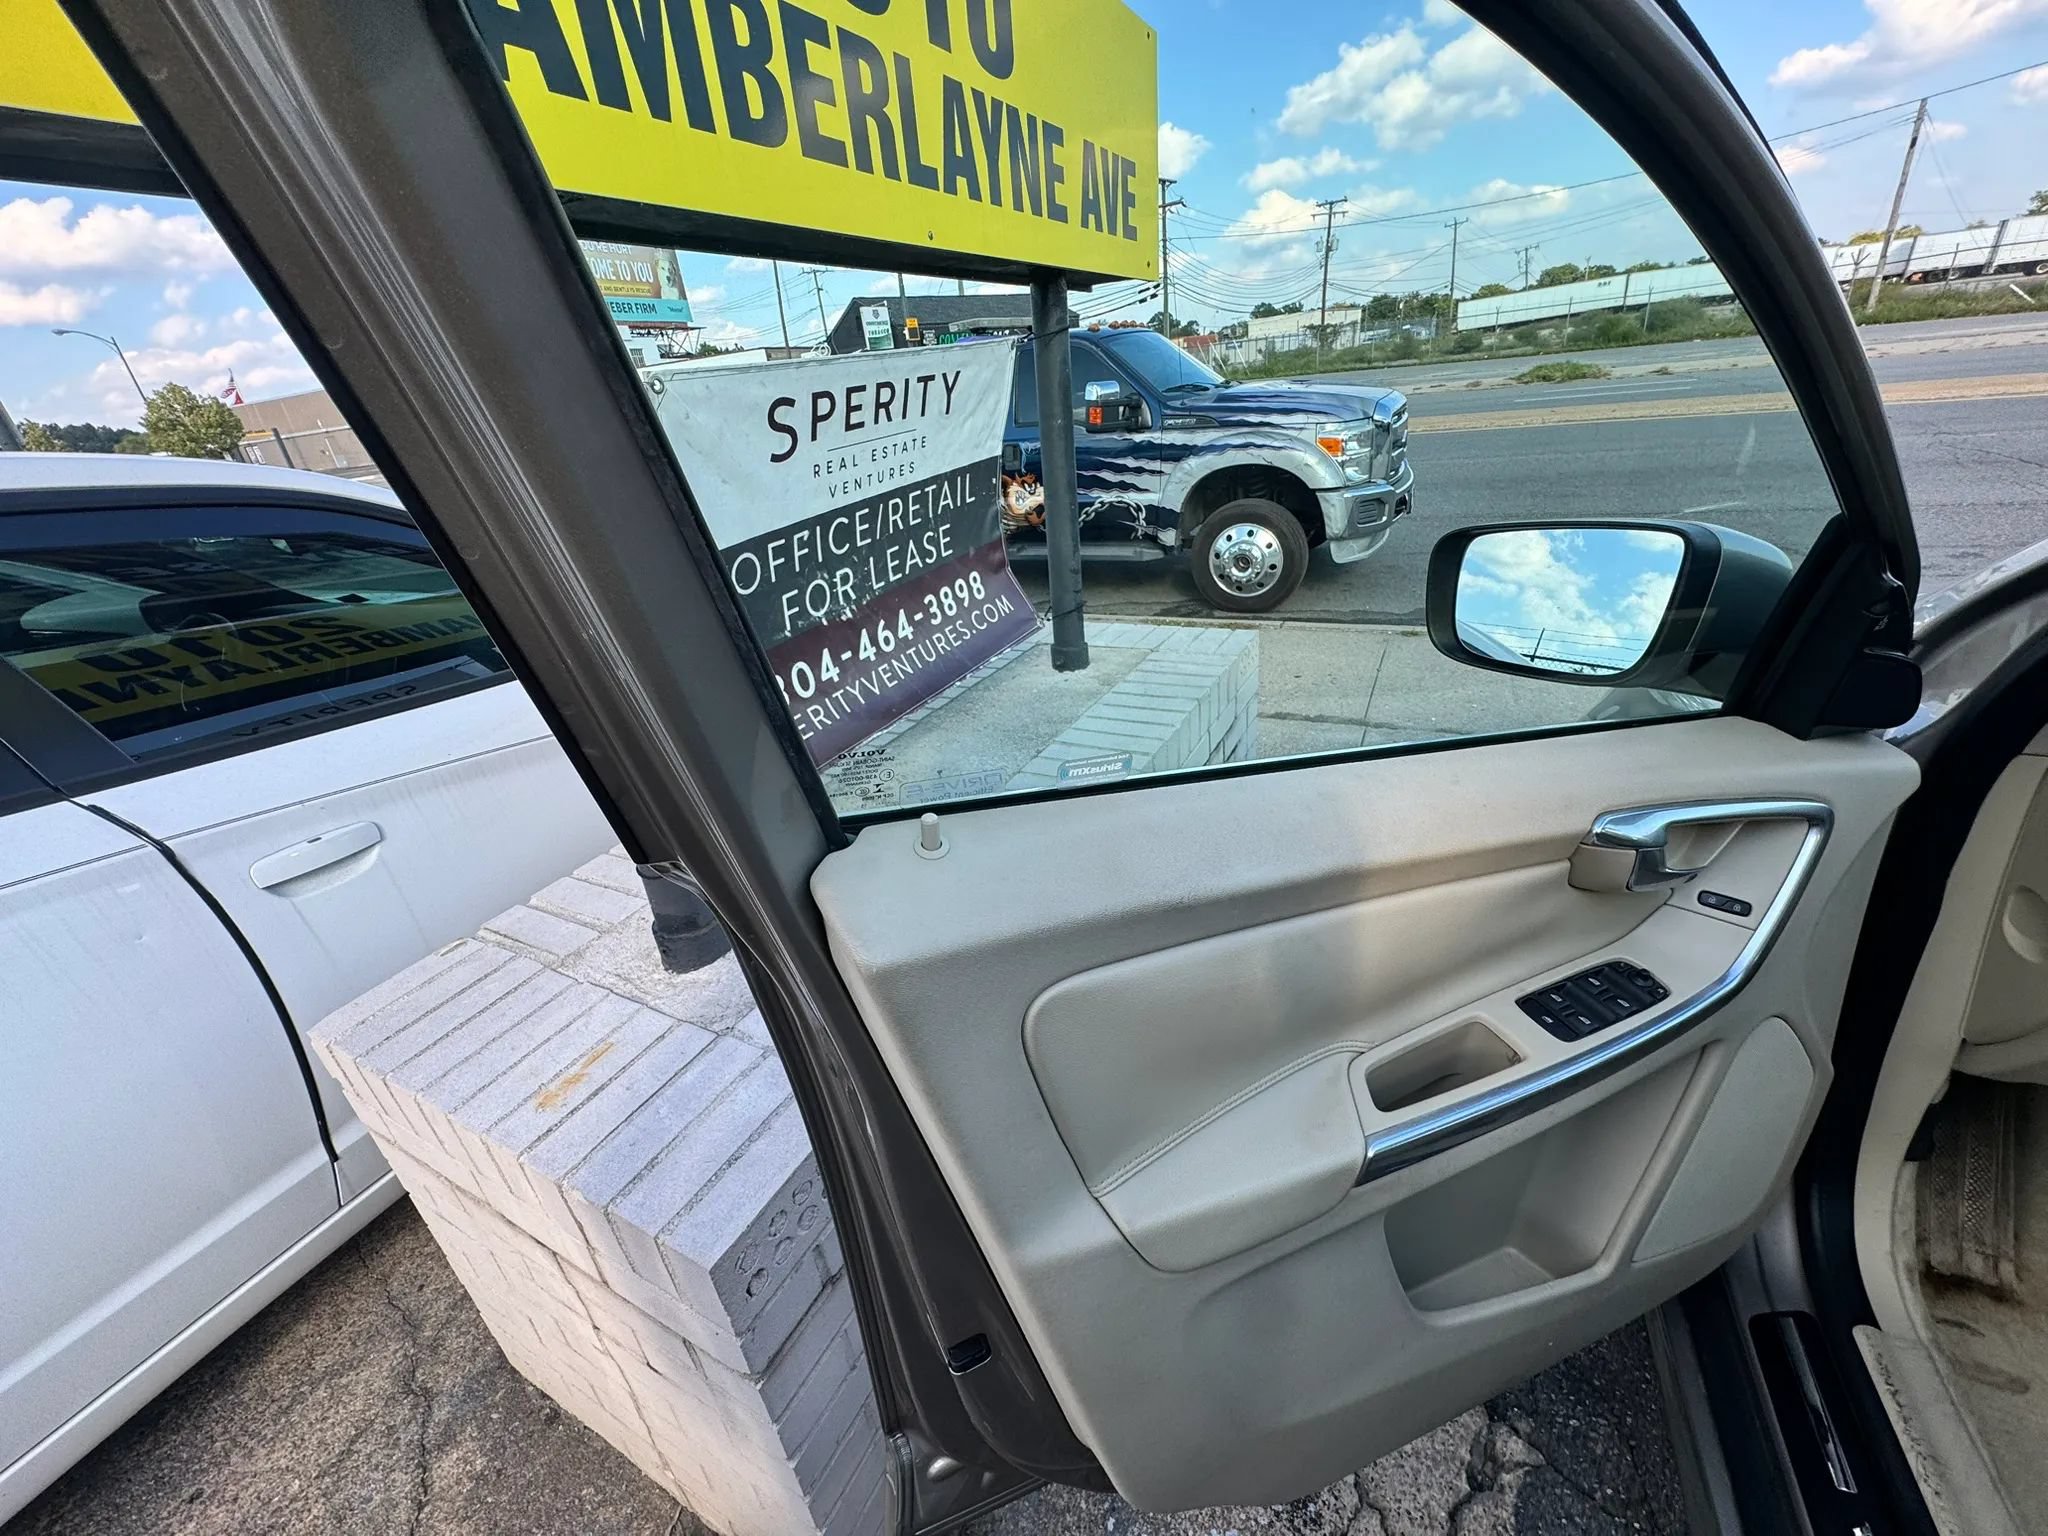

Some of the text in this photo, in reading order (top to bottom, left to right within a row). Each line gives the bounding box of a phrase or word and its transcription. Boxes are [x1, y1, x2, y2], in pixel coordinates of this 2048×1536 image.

[1081, 138, 1138, 242] AVE
[586, 257, 654, 283] OME TO YOU
[606, 301, 634, 314] EBER
[634, 302, 658, 315] FIRM
[767, 370, 961, 463] SPERITY
[813, 436, 928, 479] REAL ESTATE
[829, 461, 916, 499] VENTURES
[731, 473, 976, 595] OFFICE/RETAIL
[781, 524, 954, 632] FOR LEASE
